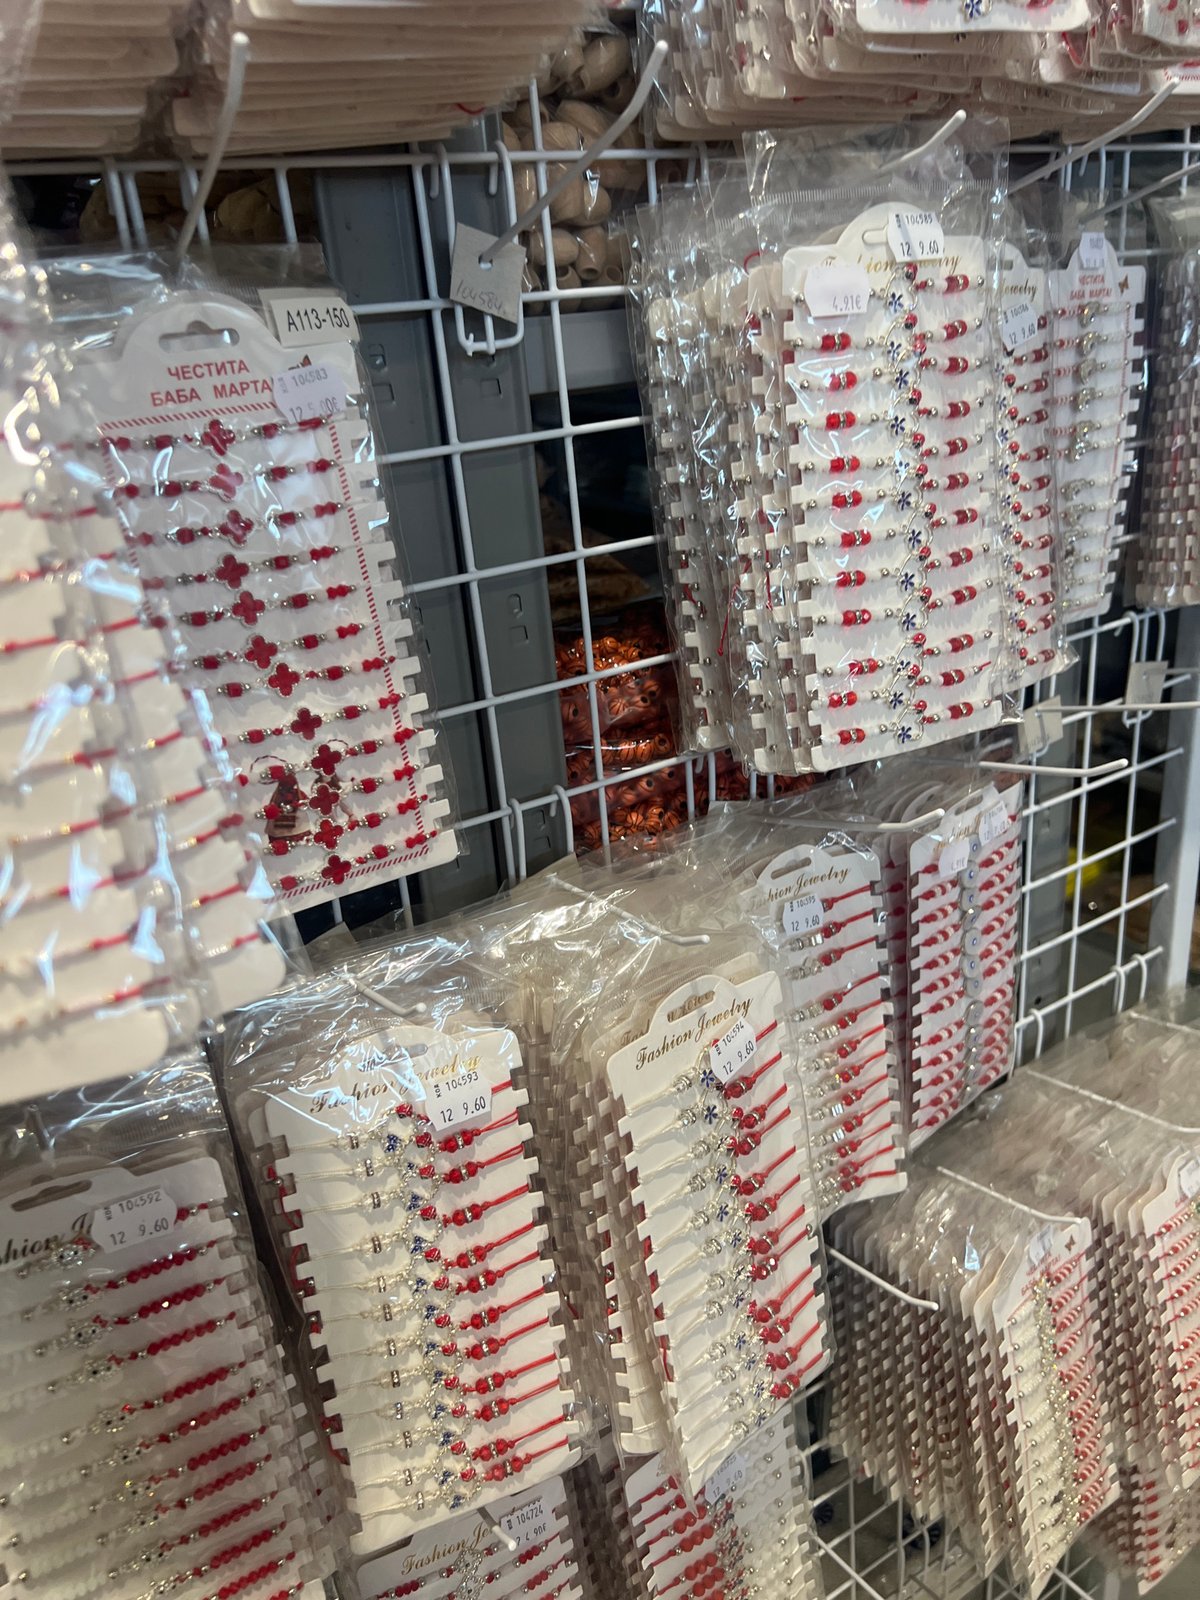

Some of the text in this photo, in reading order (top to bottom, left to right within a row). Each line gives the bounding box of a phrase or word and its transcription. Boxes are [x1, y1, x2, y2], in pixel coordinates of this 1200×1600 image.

[900, 240, 939, 257] 12 9.60
[287, 307, 350, 333] A113-150
[1009, 332, 1018, 345] 12
[167, 359, 250, 382] ЧЕСТИТА
[150, 378, 272, 408] БАБА МАРТА
[793, 866, 850, 897] Jewelry
[791, 920, 800, 932] 12
[635, 1028, 695, 1071] Fashion
[694, 998, 753, 1043] Jewelry
[722, 1040, 754, 1076] 12 9.60
[445, 1071, 479, 1092] 104593
[440, 1095, 487, 1124] 12 9.60
[118, 1190, 162, 1214] 104592
[109, 1217, 170, 1246] 12 9.60
[516, 1504, 544, 1526] 104724
[401, 1539, 468, 1576] Fashion
